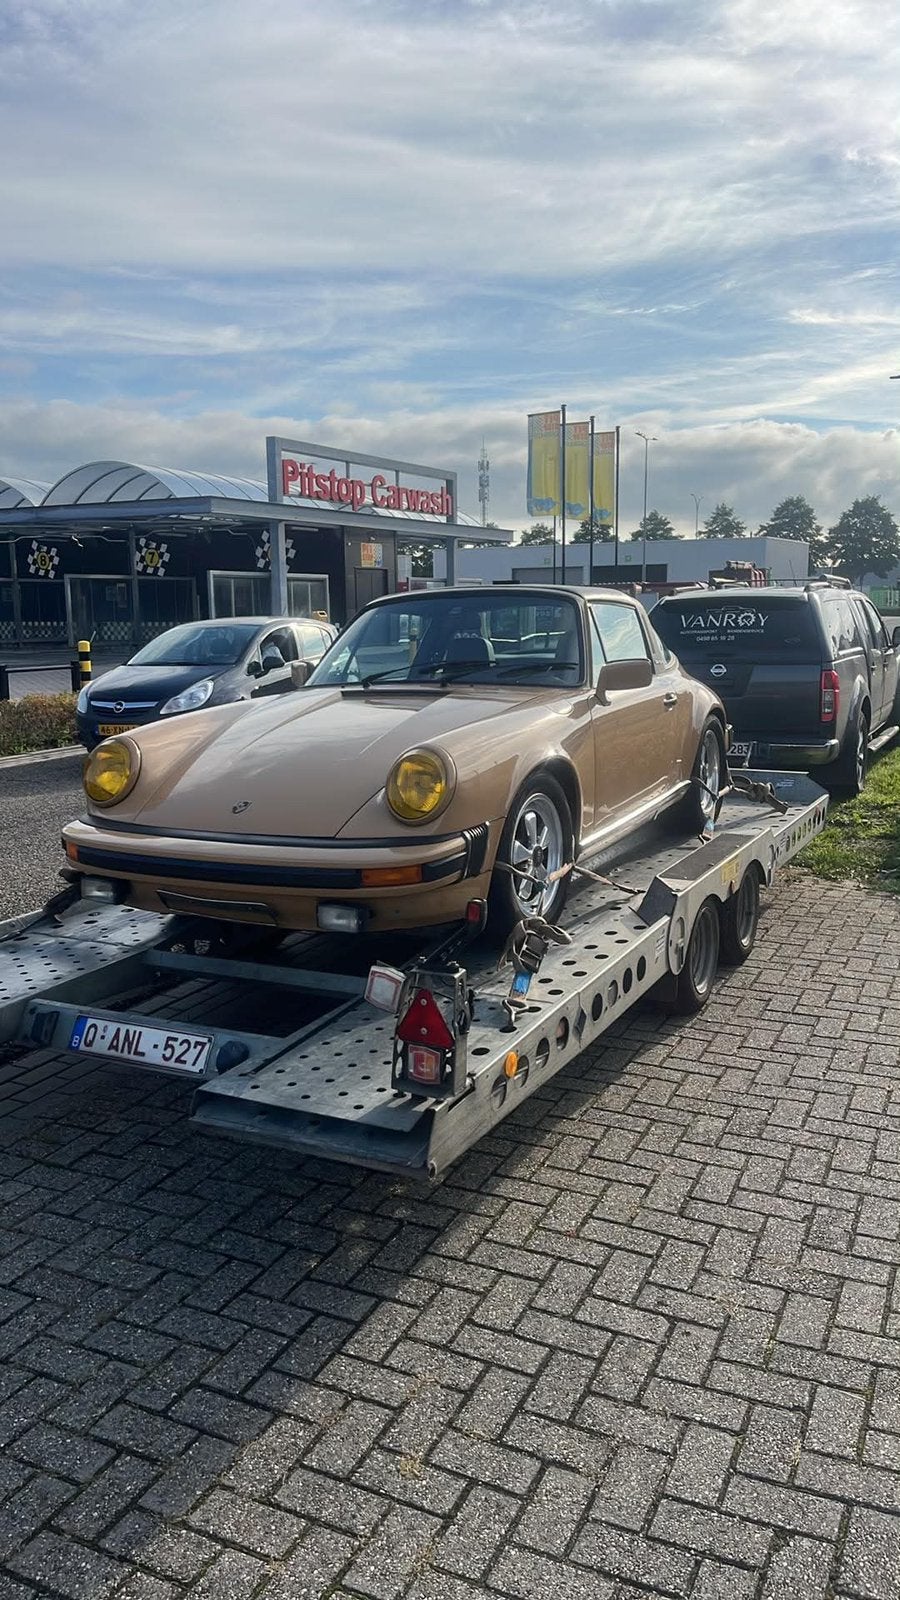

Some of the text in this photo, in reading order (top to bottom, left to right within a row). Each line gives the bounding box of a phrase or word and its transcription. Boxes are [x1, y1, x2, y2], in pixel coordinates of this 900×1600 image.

[282, 459, 453, 516] Pitstop Carwash
[148, 552, 156, 564] 7
[680, 613, 768, 628] VANROY
